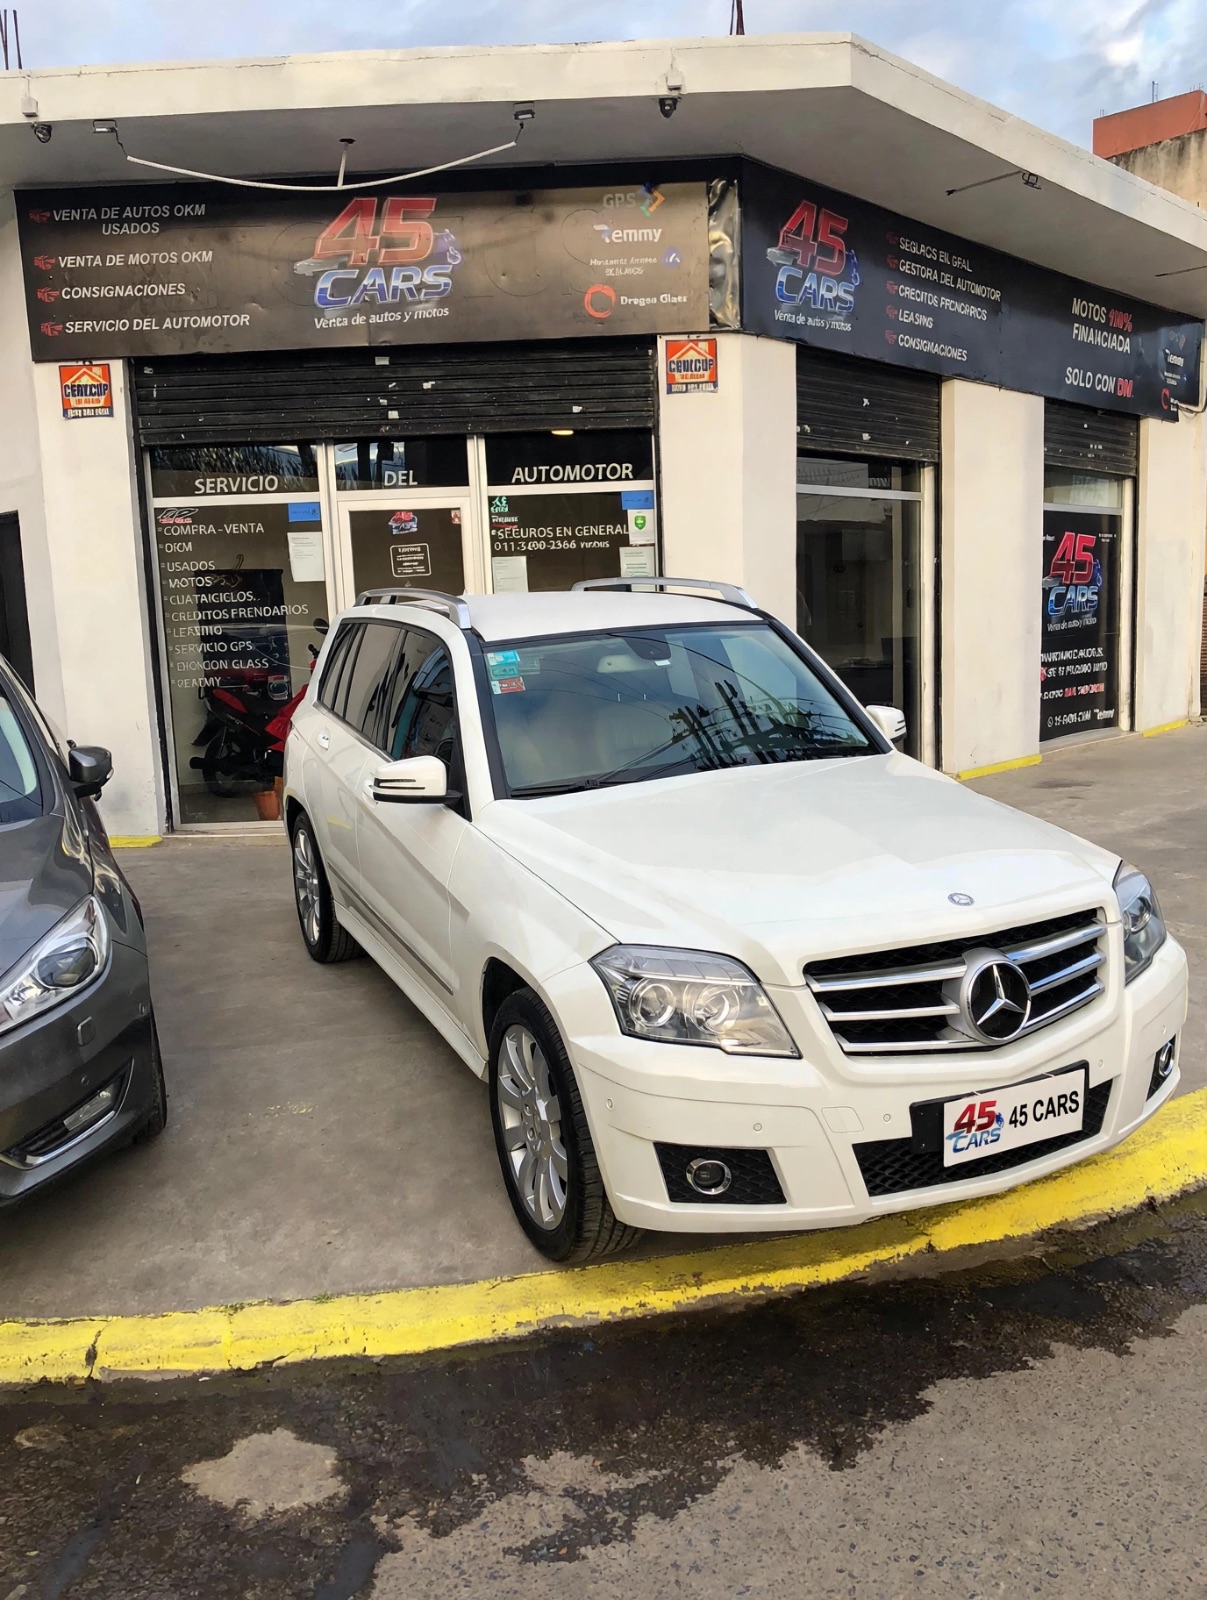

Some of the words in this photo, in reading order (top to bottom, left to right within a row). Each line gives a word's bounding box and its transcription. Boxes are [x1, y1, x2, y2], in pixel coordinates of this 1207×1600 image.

[603, 192, 637, 209] GPS
[53, 208, 98, 221] VENTA
[101, 207, 120, 219] DE
[122, 205, 170, 218] AUTOS
[102, 222, 160, 235] USADOS
[313, 197, 437, 267] 45
[777, 200, 849, 276] 45
[58, 255, 102, 268] VENTA
[106, 254, 125, 266] DE
[128, 252, 178, 265] MOTOS
[313, 264, 453, 308] CARS
[776, 266, 855, 313] CARS
[940, 272, 955, 288] DEL
[61, 282, 186, 300] CONSIGNACIONES
[351, 313, 367, 325] de
[369, 310, 401, 323] autos
[403, 310, 412, 322] y
[774, 309, 796, 324] Venta
[796, 312, 806, 325] de
[825, 320, 831, 330] y
[1071, 297, 1107, 323] MOTOS
[65, 319, 130, 334] SERVICIO
[133, 318, 160, 331] DEL
[162, 314, 250, 329] AUTOMOTOR
[1095, 373, 1116, 394] CON
[194, 475, 279, 494] SERVICIO
[384, 470, 418, 487] DEL
[511, 463, 634, 484] AUTOMOTOR
[224, 523, 265, 534] VENTA
[557, 525, 572, 538] EN
[167, 561, 216, 572] USADOS
[1049, 531, 1097, 584] 45
[1047, 586, 1099, 615] CARS
[174, 642, 228, 655] SERVICIO
[230, 641, 253, 652] GPS
[232, 658, 269, 670] GLASS
[953, 1100, 997, 1134] 45
[1009, 1103, 1028, 1128] 45
[1033, 1090, 1080, 1122] CARS
[951, 1128, 1001, 1154] CARS
